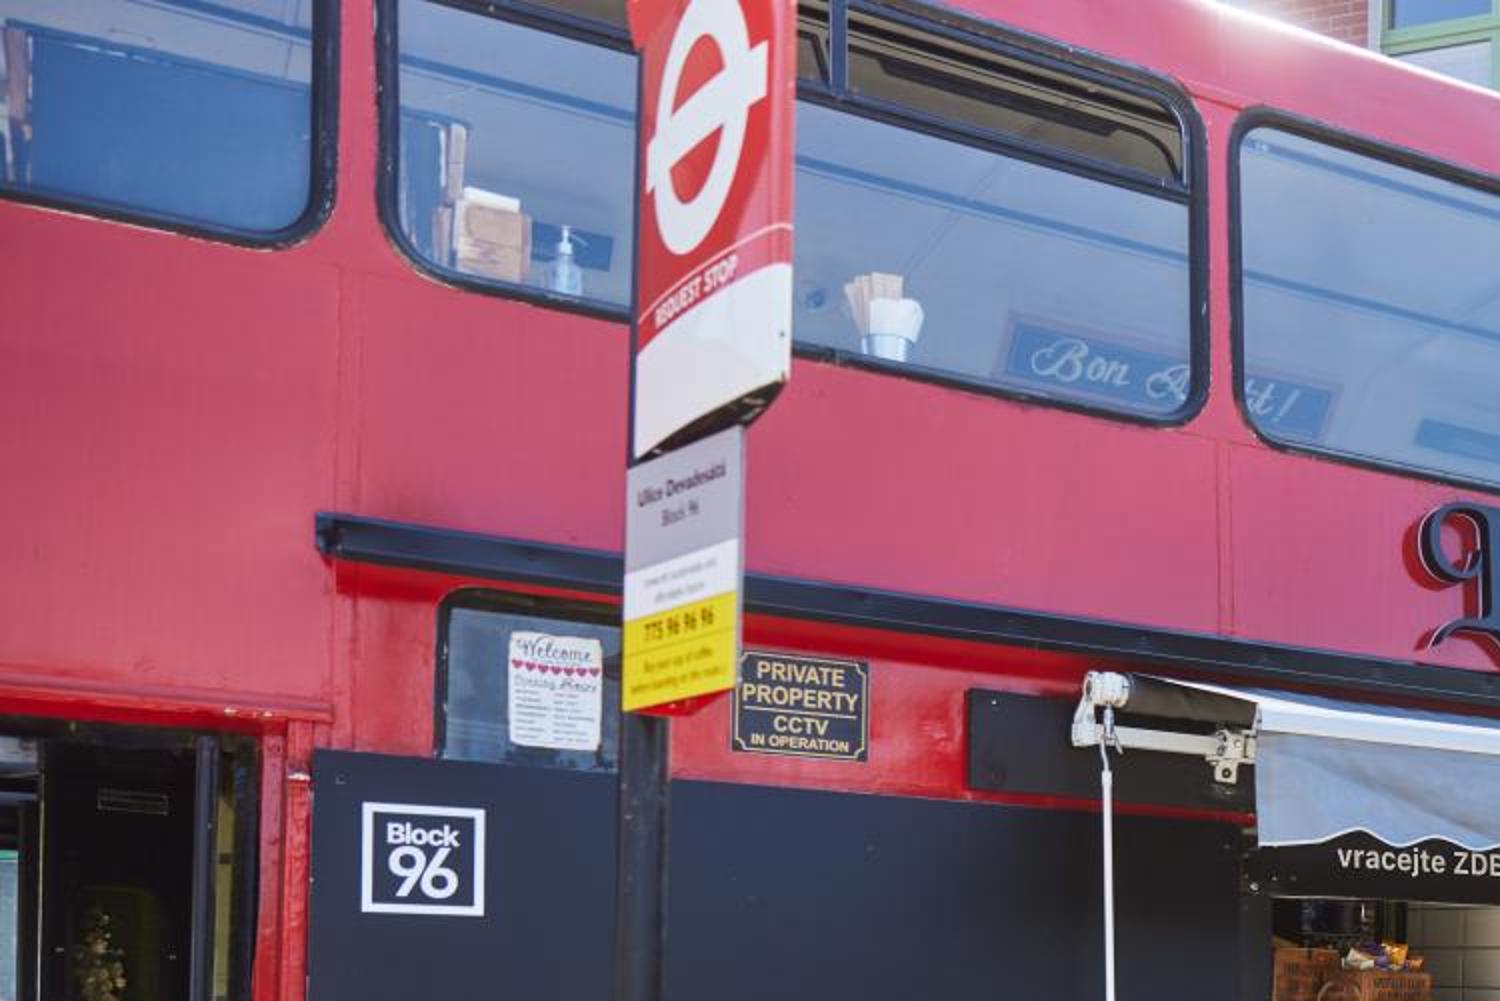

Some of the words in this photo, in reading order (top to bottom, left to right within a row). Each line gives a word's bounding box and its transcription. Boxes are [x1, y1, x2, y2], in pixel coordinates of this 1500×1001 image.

[703, 254, 738, 293] STOP
[1030, 338, 1131, 384] Bon
[517, 636, 592, 661] Welcome
[756, 660, 846, 688] PRIVATE
[742, 683, 859, 713] PROPERTY
[773, 715, 829, 736] CCTV
[751, 733, 765, 746] IN
[768, 734, 849, 753] OPERATION
[386, 821, 461, 848] Block
[387, 845, 459, 899] 96
[1337, 847, 1446, 878] vracejte
